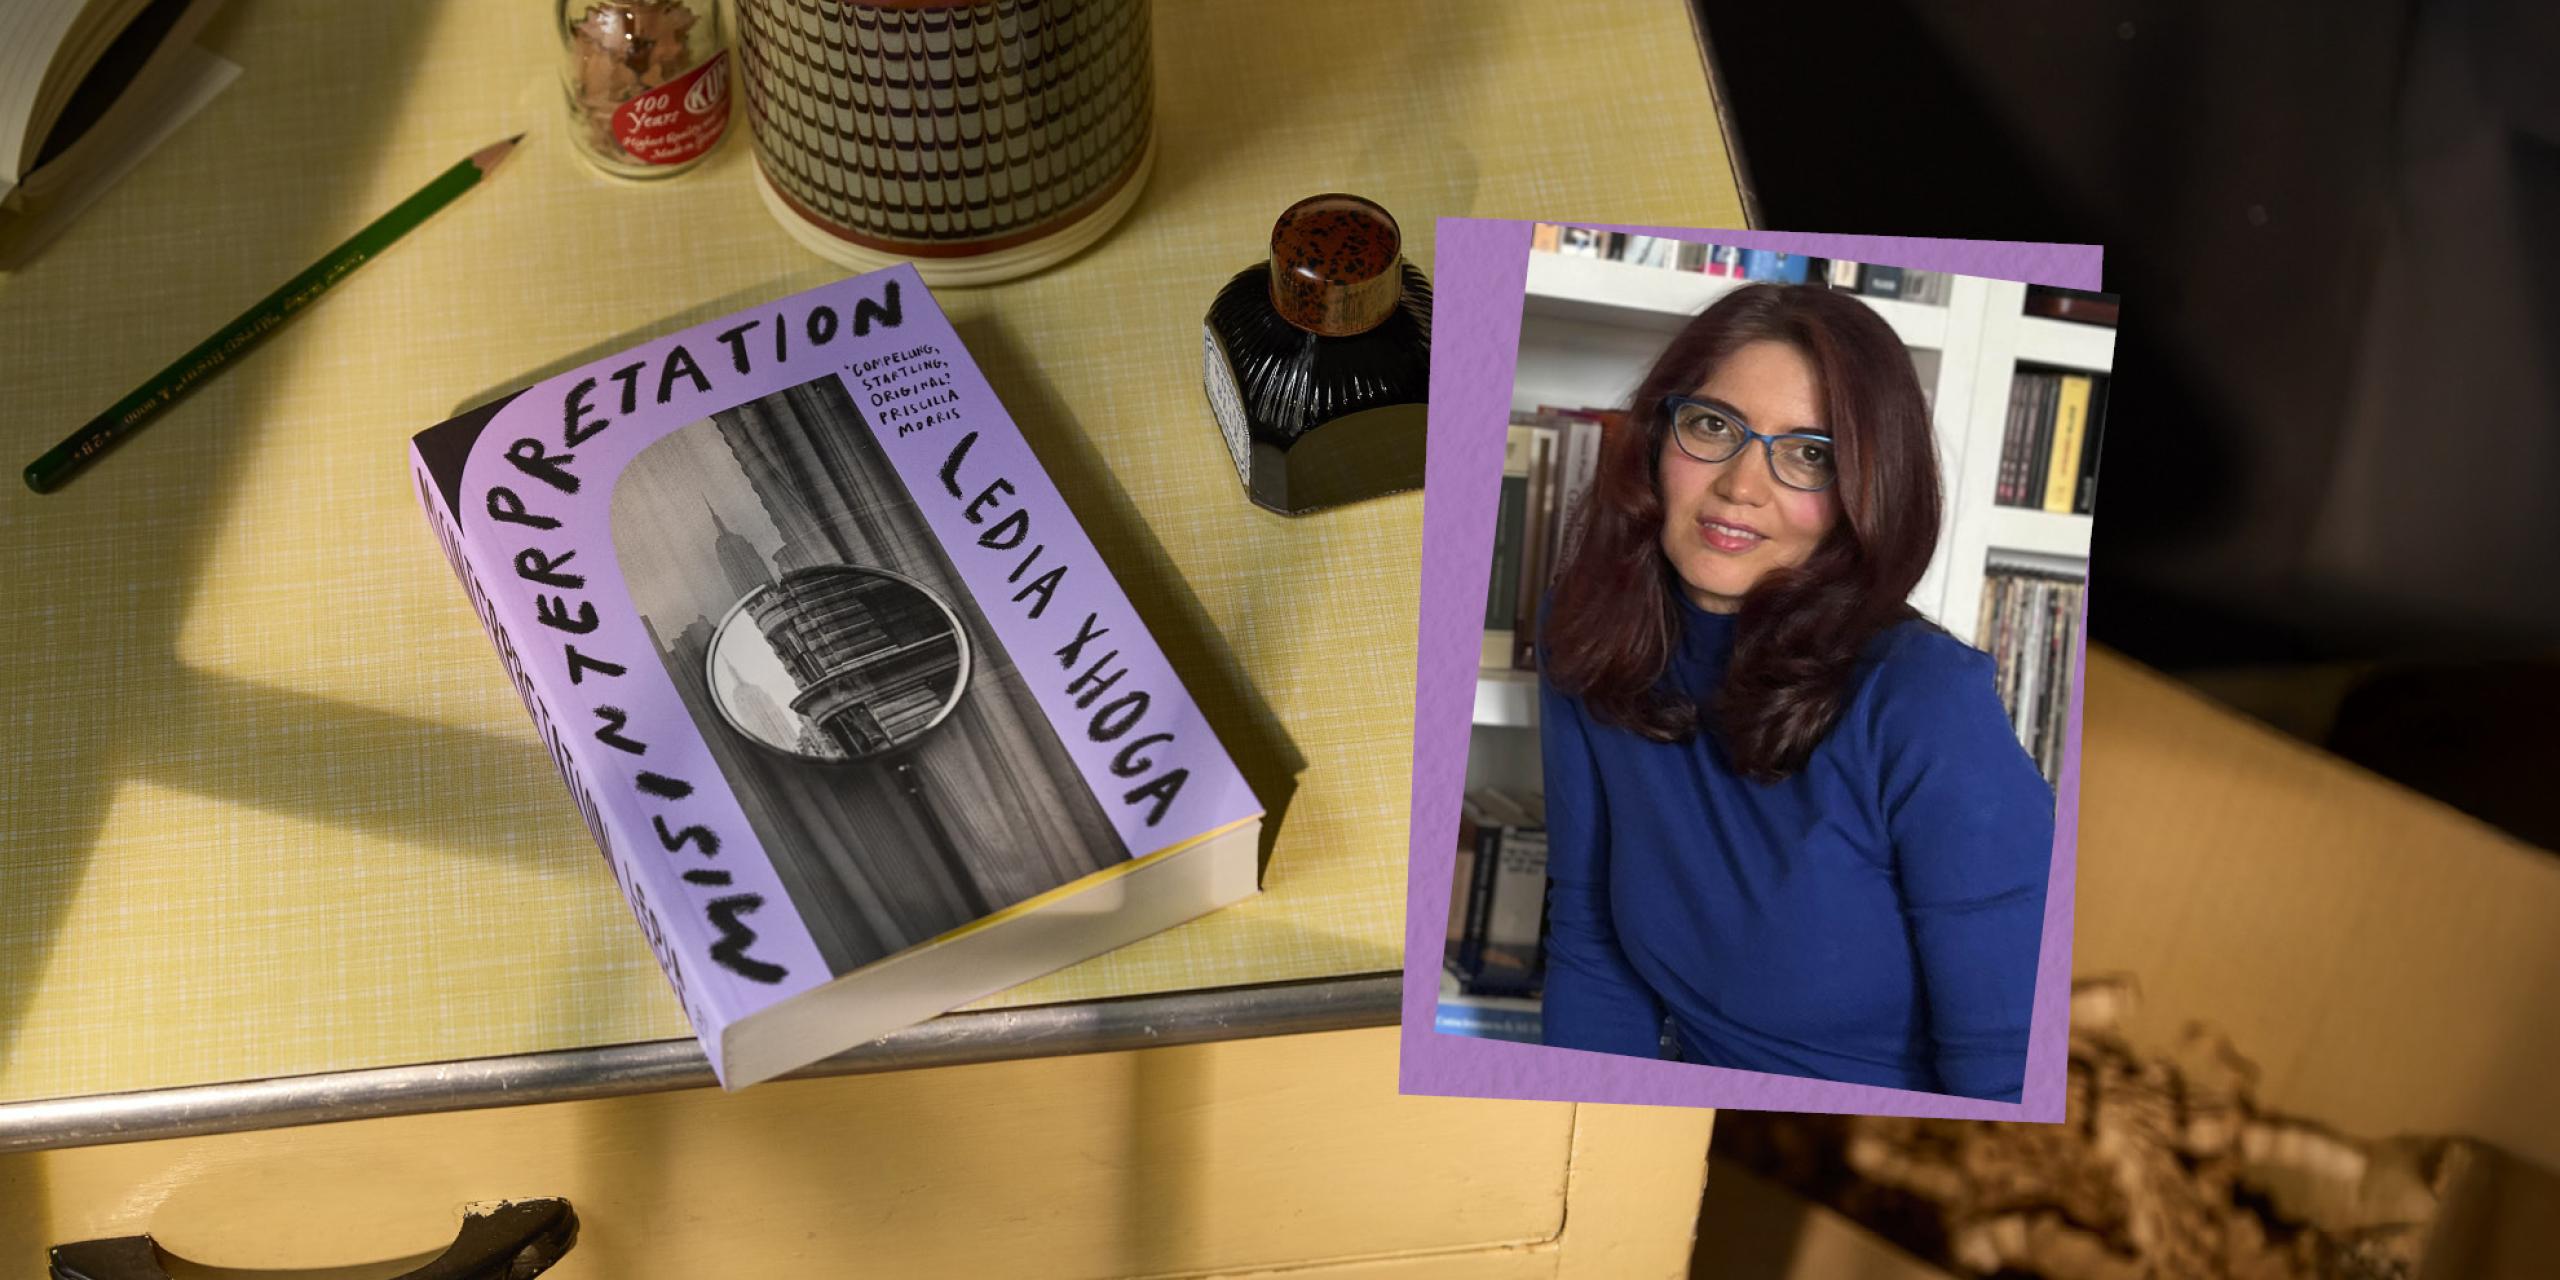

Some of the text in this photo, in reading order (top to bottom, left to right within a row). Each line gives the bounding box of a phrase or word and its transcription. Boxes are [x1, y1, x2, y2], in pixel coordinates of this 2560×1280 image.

[634, 94, 670, 113] 100
[627, 110, 680, 134] Years
[862, 359, 949, 391] STARTLING,
[879, 389, 960, 425] PRISCILLA
[898, 408, 961, 438] MORRIS
[939, 431, 1069, 620] LEDIA
[486, 279, 903, 984] MISINTERPRETATION
[1055, 612, 1189, 827] XHOGA
